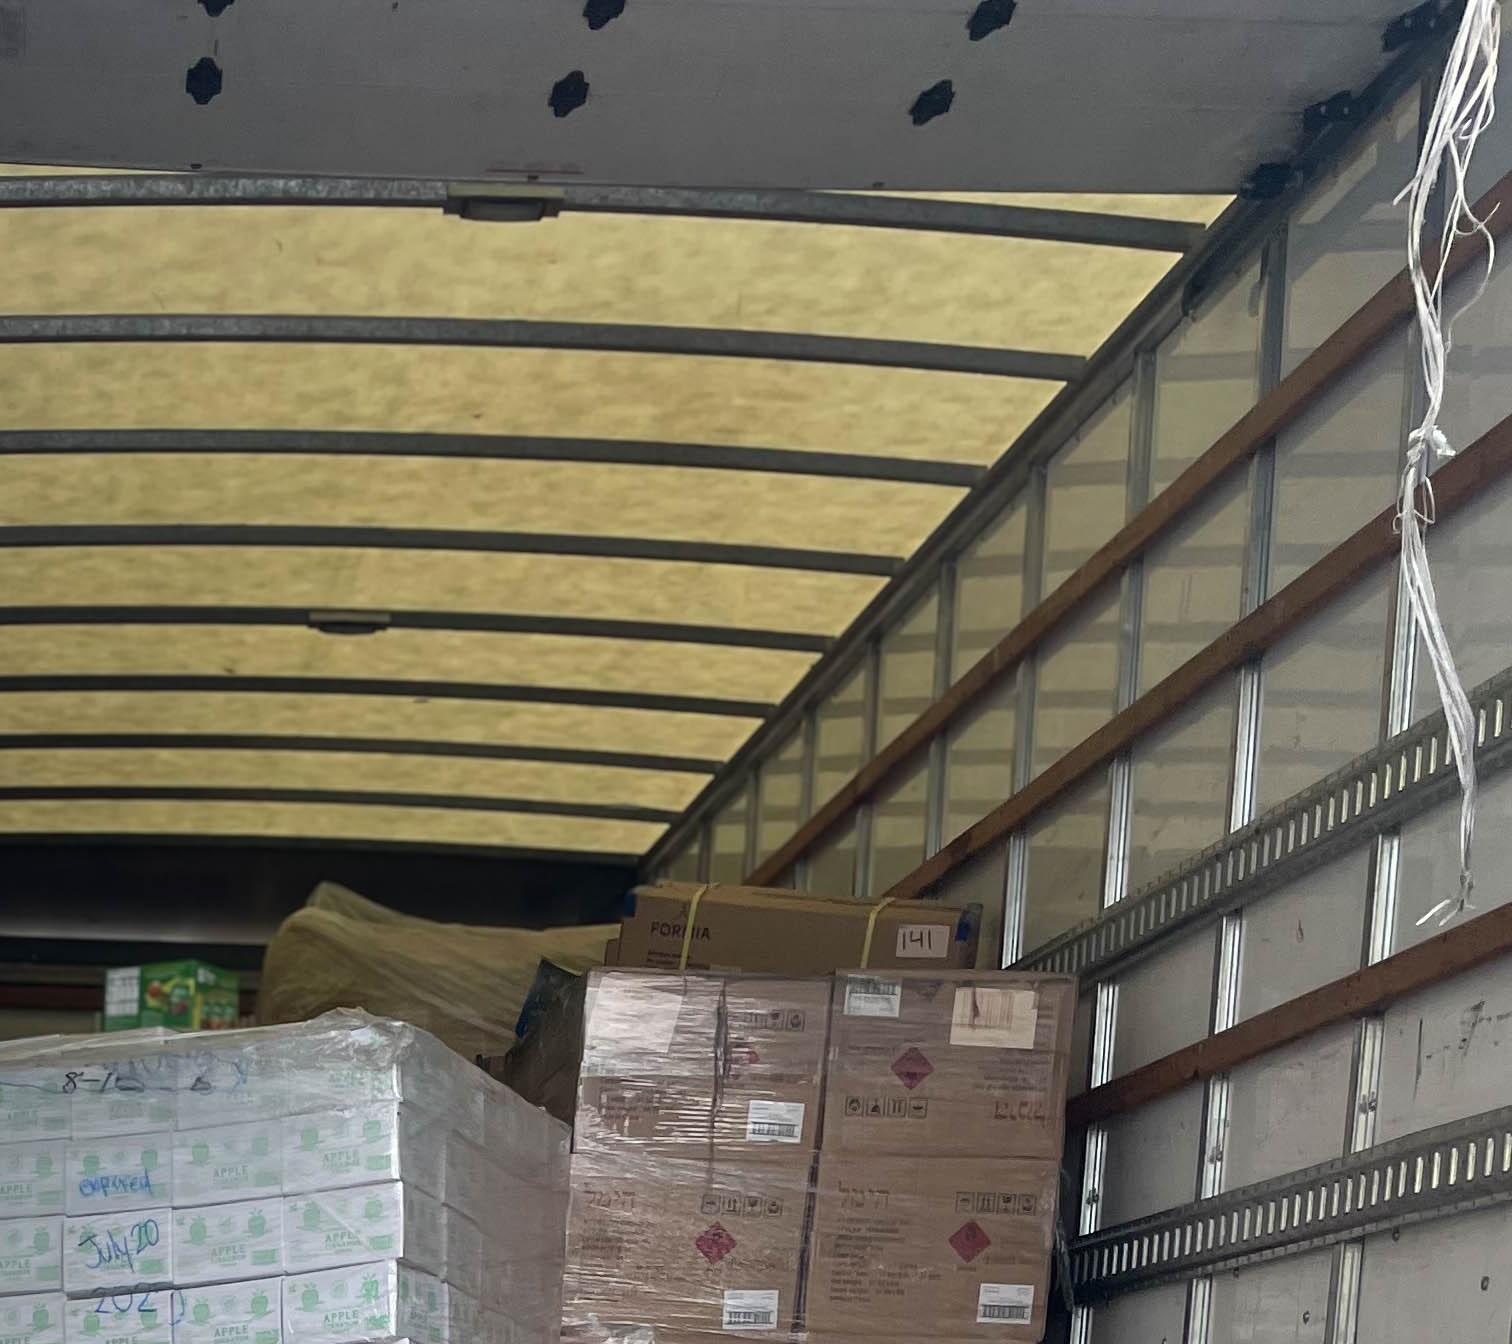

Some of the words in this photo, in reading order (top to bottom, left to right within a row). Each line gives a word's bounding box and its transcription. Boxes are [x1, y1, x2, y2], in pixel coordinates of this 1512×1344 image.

[902, 928, 933, 950] 141
[0, 1184, 33, 1194] APPLE
[326, 1230, 360, 1242] APPLE
[77, 1229, 135, 1273] July
[0, 1259, 30, 1270] APPLE
[324, 1310, 359, 1322] APPLE
[214, 1325, 248, 1338] APPLE
